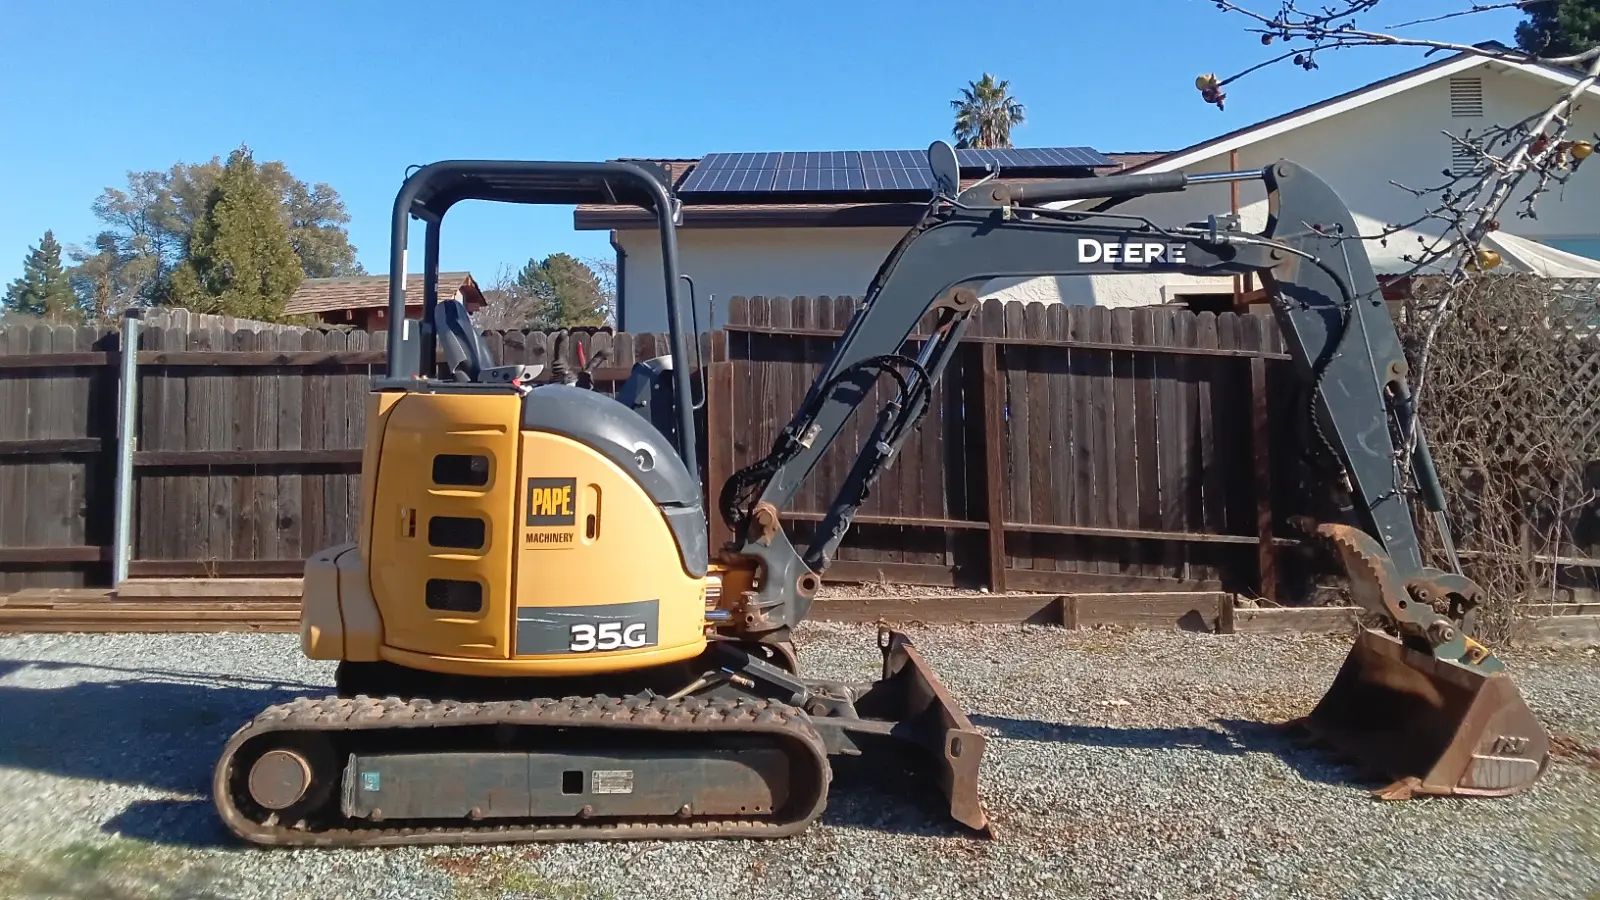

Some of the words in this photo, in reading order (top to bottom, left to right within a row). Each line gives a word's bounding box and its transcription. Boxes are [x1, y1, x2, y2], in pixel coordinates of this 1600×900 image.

[1078, 238, 1186, 263] DEERE
[526, 533, 574, 544] MACHINERY
[569, 621, 647, 652] 35G
